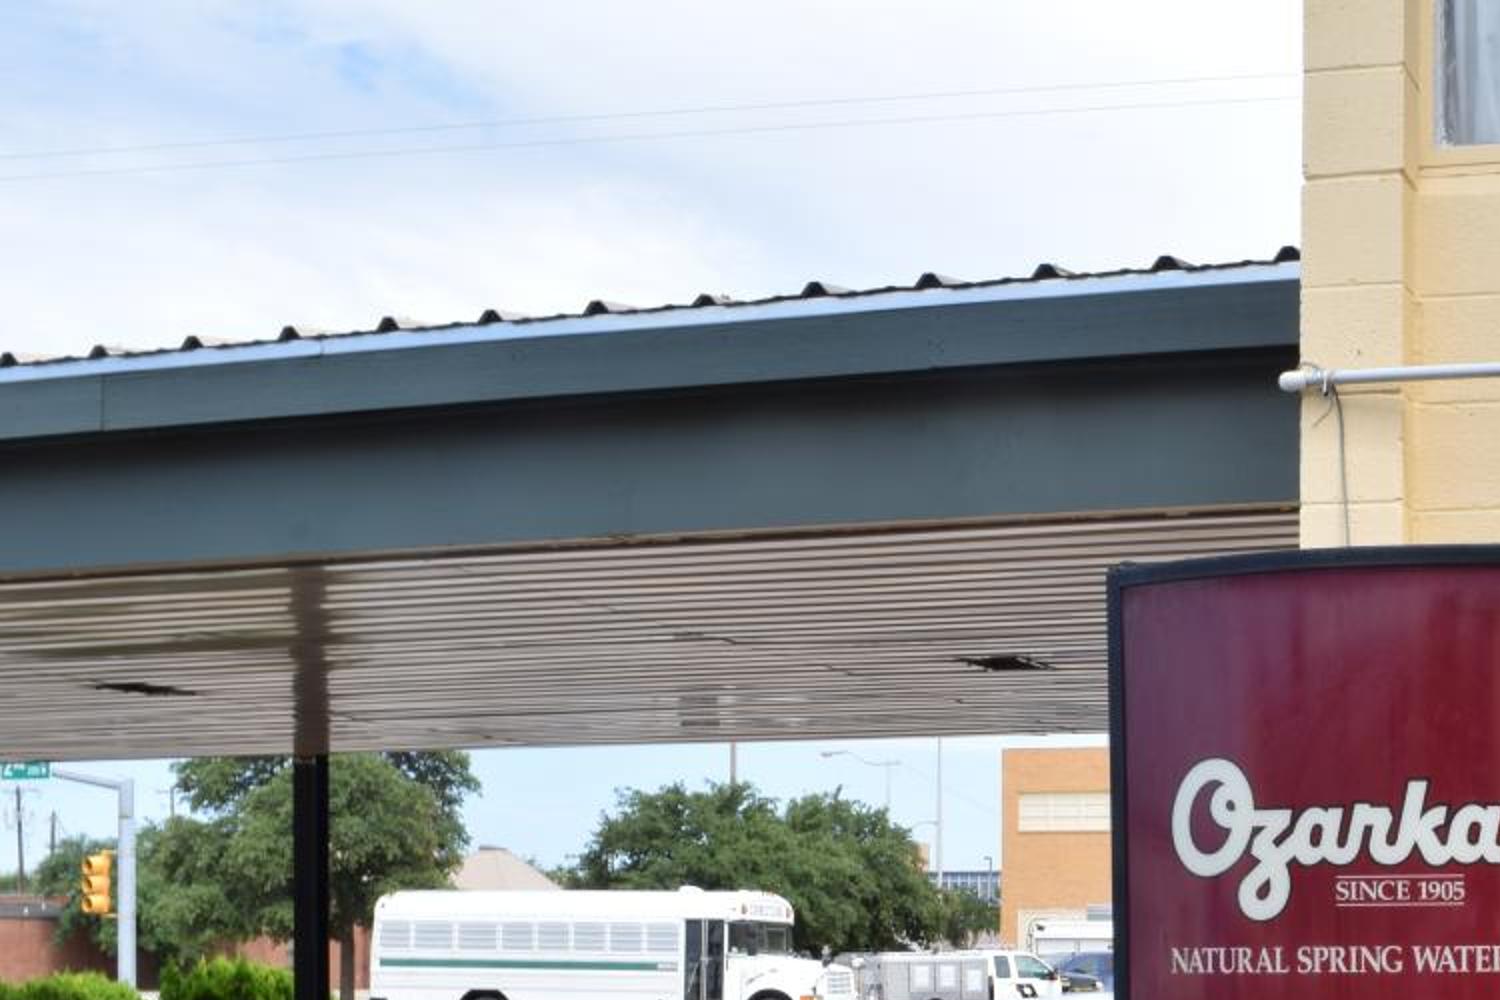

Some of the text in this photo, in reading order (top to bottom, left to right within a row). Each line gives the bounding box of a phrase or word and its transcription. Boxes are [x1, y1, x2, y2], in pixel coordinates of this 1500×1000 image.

[1335, 880, 1466, 901] SINCE 1905
[1170, 947, 1289, 975] NATURAL
[1297, 946, 1403, 974] SPRING
